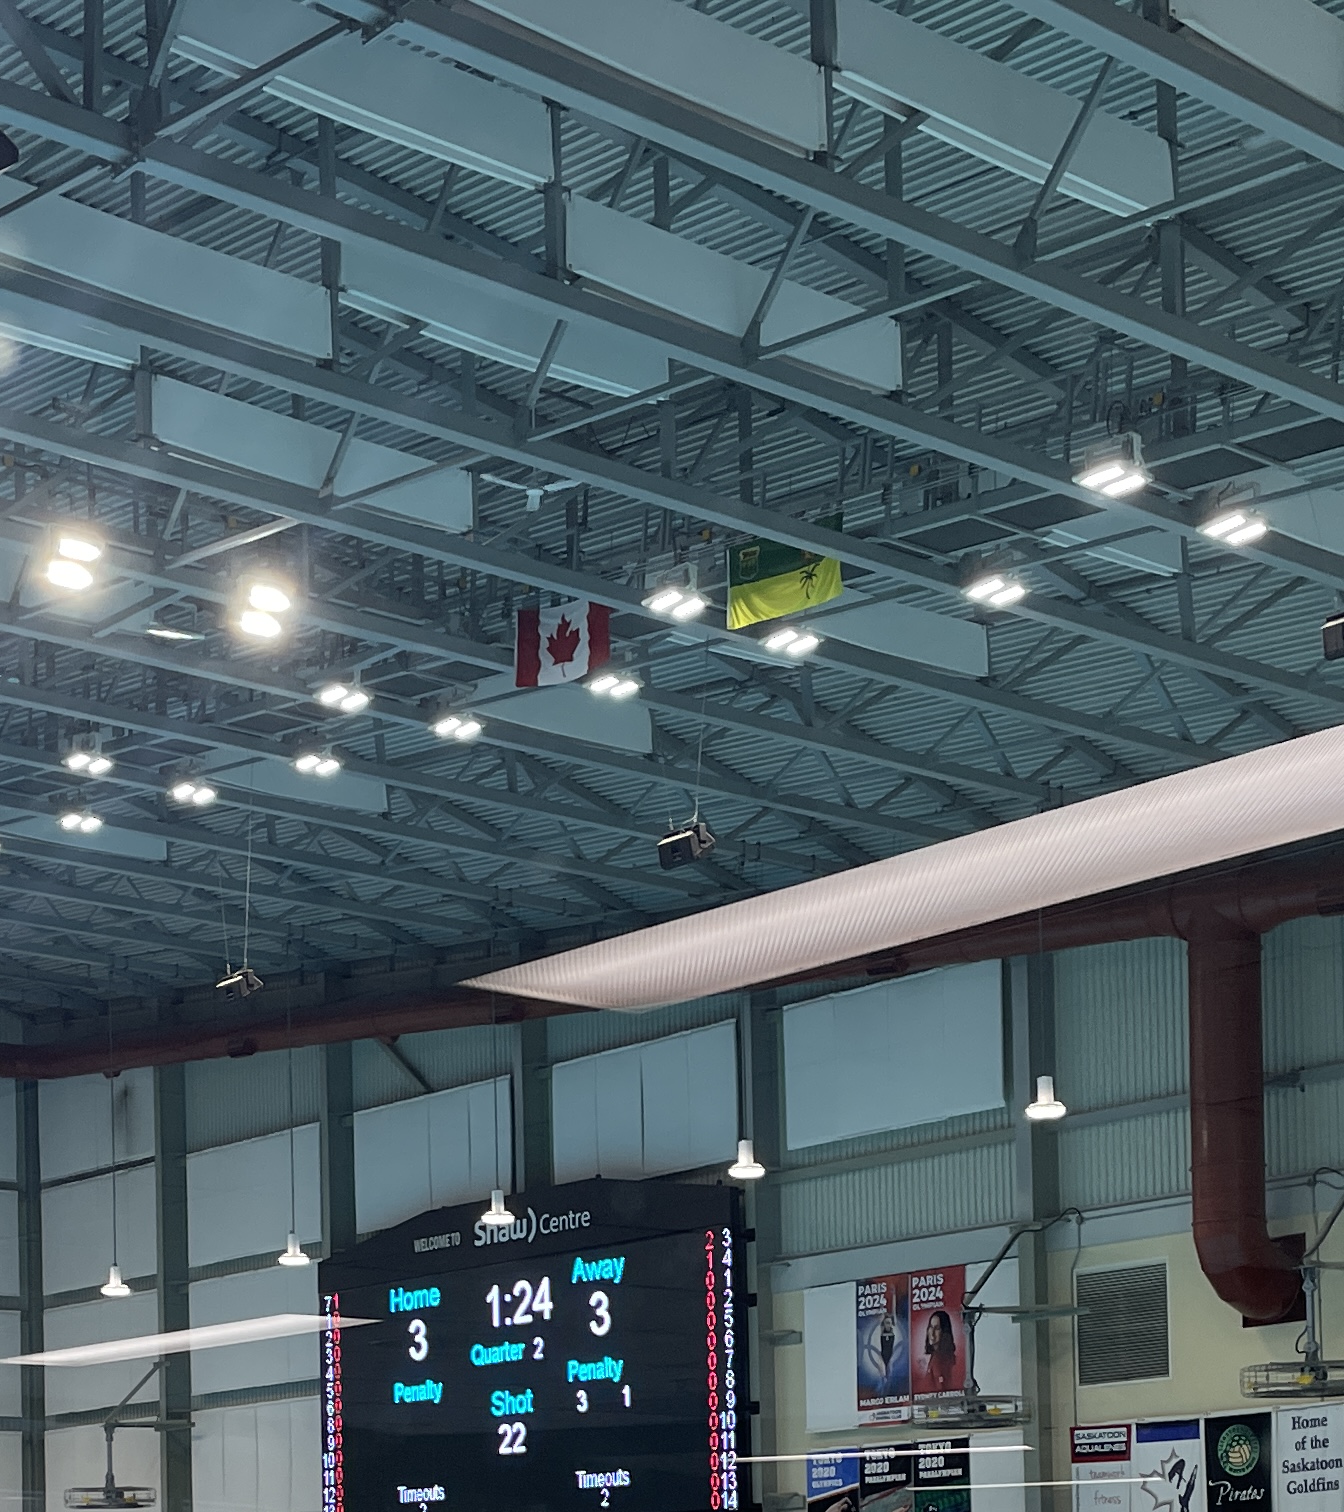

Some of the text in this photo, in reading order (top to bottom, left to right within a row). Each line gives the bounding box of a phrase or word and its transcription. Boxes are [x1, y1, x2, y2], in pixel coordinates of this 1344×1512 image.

[413, 1234, 450, 1253] WELCOME
[450, 1231, 461, 1246] TO
[540, 1211, 591, 1235] Centre
[722, 1228, 732, 1247] 3
[722, 1248, 732, 1266] 4
[571, 1256, 625, 1284] Away
[724, 1268, 731, 1287] 1
[858, 1282, 887, 1296] PARIS
[912, 1273, 944, 1288] PARIS
[389, 1287, 441, 1313] Home
[486, 1276, 553, 1327] 1:24
[723, 1289, 733, 1308] 2
[858, 1294, 887, 1309] 2024
[912, 1286, 944, 1303] 2024
[589, 1290, 611, 1337] 3
[724, 1309, 734, 1327] 5
[408, 1318, 429, 1361] 3
[724, 1329, 734, 1347] 6
[470, 1336, 545, 1366] Quarter 2
[725, 1349, 734, 1368] 7
[567, 1355, 624, 1383] Penalty
[726, 1370, 735, 1388] 8
[393, 1379, 443, 1404] Penalty
[576, 1384, 631, 1413] 3 1
[726, 1390, 735, 1408] 9
[490, 1388, 534, 1417] Shot
[719, 1410, 736, 1429] 10
[1291, 1415, 1328, 1430] Home
[497, 1421, 527, 1455] 22
[721, 1431, 735, 1450] 11
[1075, 1431, 1126, 1441] SASKATOON
[1294, 1434, 1329, 1451] of the
[720, 1451, 736, 1470] 12
[864, 1462, 890, 1474] 2020
[918, 1456, 944, 1469] 2020
[1282, 1457, 1343, 1474] Saskatoon
[575, 1468, 631, 1489] Timeouts
[721, 1471, 737, 1490] 13
[812, 1466, 836, 1479] 2020
[397, 1484, 445, 1504] Timeouts
[1208, 1480, 1266, 1505] Pirates
[1286, 1477, 1340, 1495] Goldfins
[600, 1488, 610, 1507] 2
[721, 1490, 738, 1510] 14
